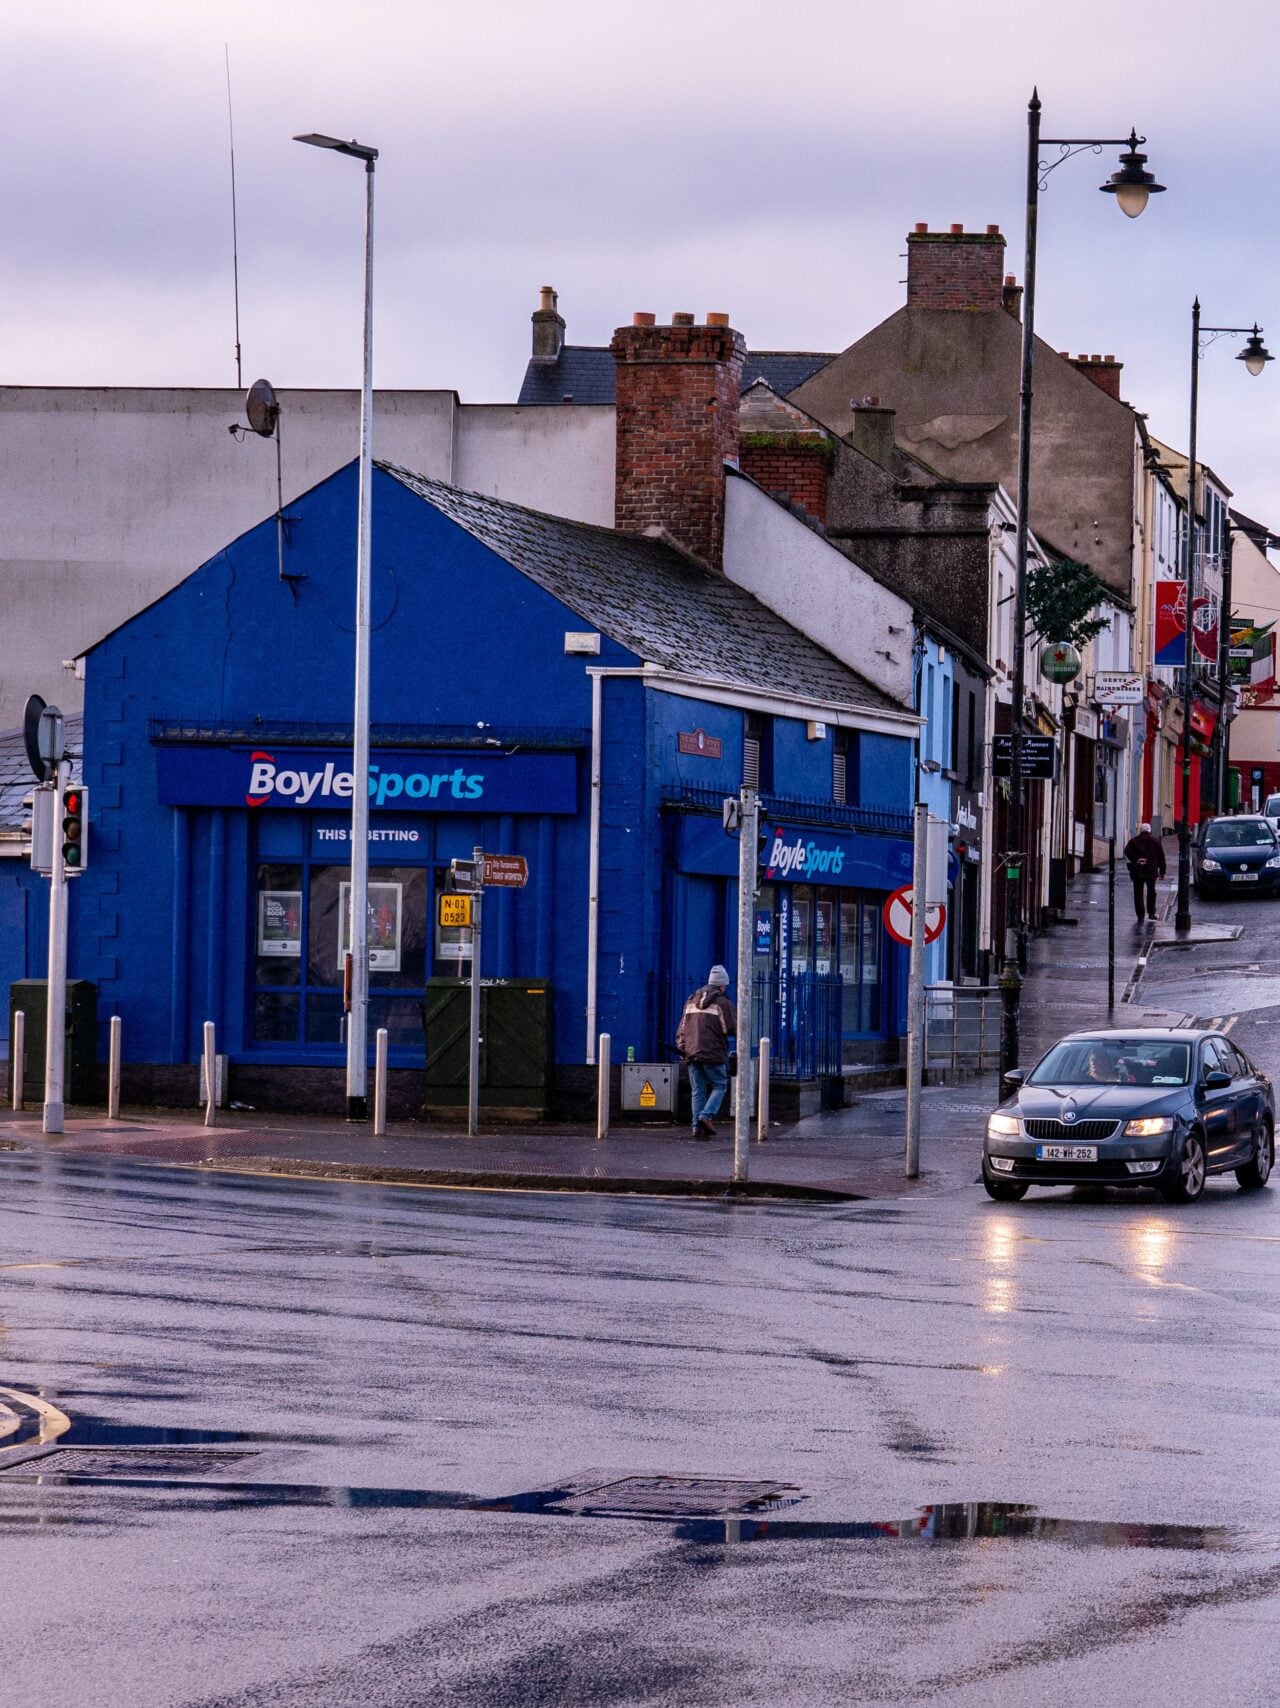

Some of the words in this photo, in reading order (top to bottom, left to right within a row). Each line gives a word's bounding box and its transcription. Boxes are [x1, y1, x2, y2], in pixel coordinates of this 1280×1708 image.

[317, 829, 347, 841] THIS
[770, 838, 845, 878] BoyleSports
[444, 900, 465, 909] N-03
[444, 913, 466, 923] 0523
[757, 920, 771, 935] Boyle
[1047, 1148, 1092, 1159] 142-WH-252
